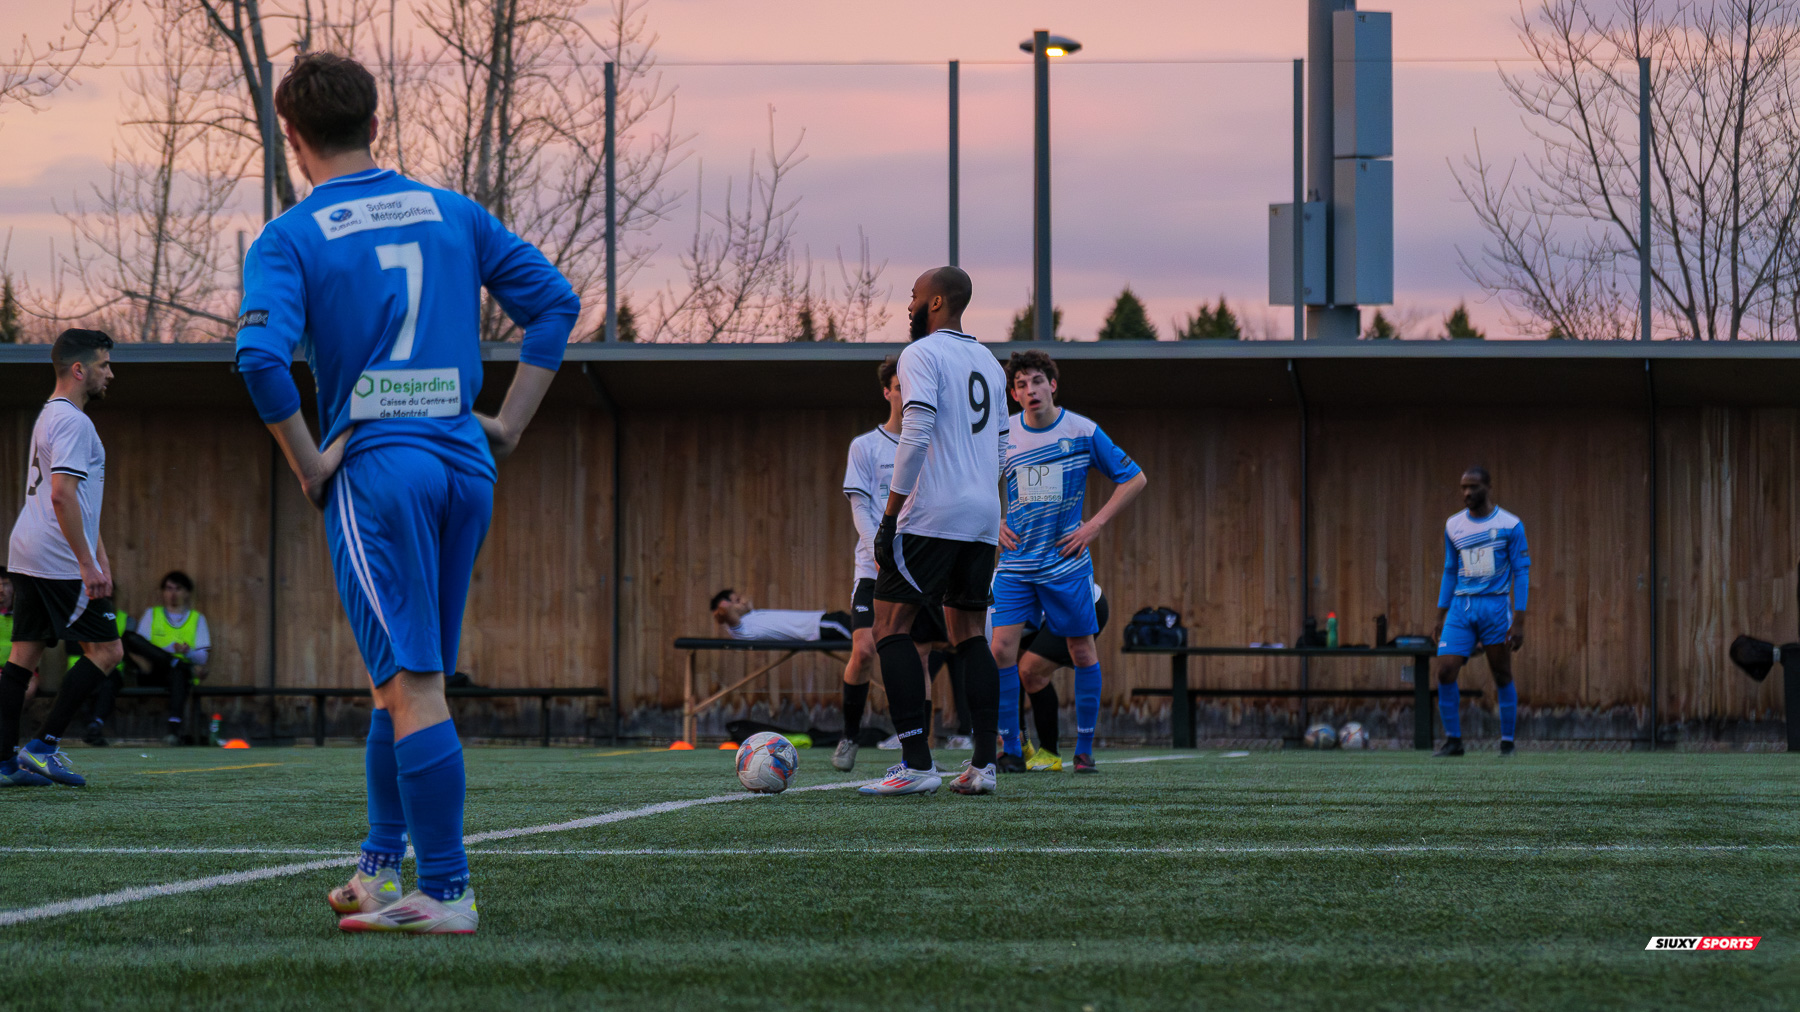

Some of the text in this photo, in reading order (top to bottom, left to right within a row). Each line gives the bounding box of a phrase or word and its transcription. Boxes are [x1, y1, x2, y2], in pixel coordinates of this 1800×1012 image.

[365, 200, 402, 212] Subaru
[375, 241, 424, 362] 7
[380, 377, 456, 397] Desjardins
[380, 398, 407, 407] Caisse
[409, 398, 419, 406] du
[968, 370, 990, 434] 9
[380, 408, 428, 418] de Montréal
